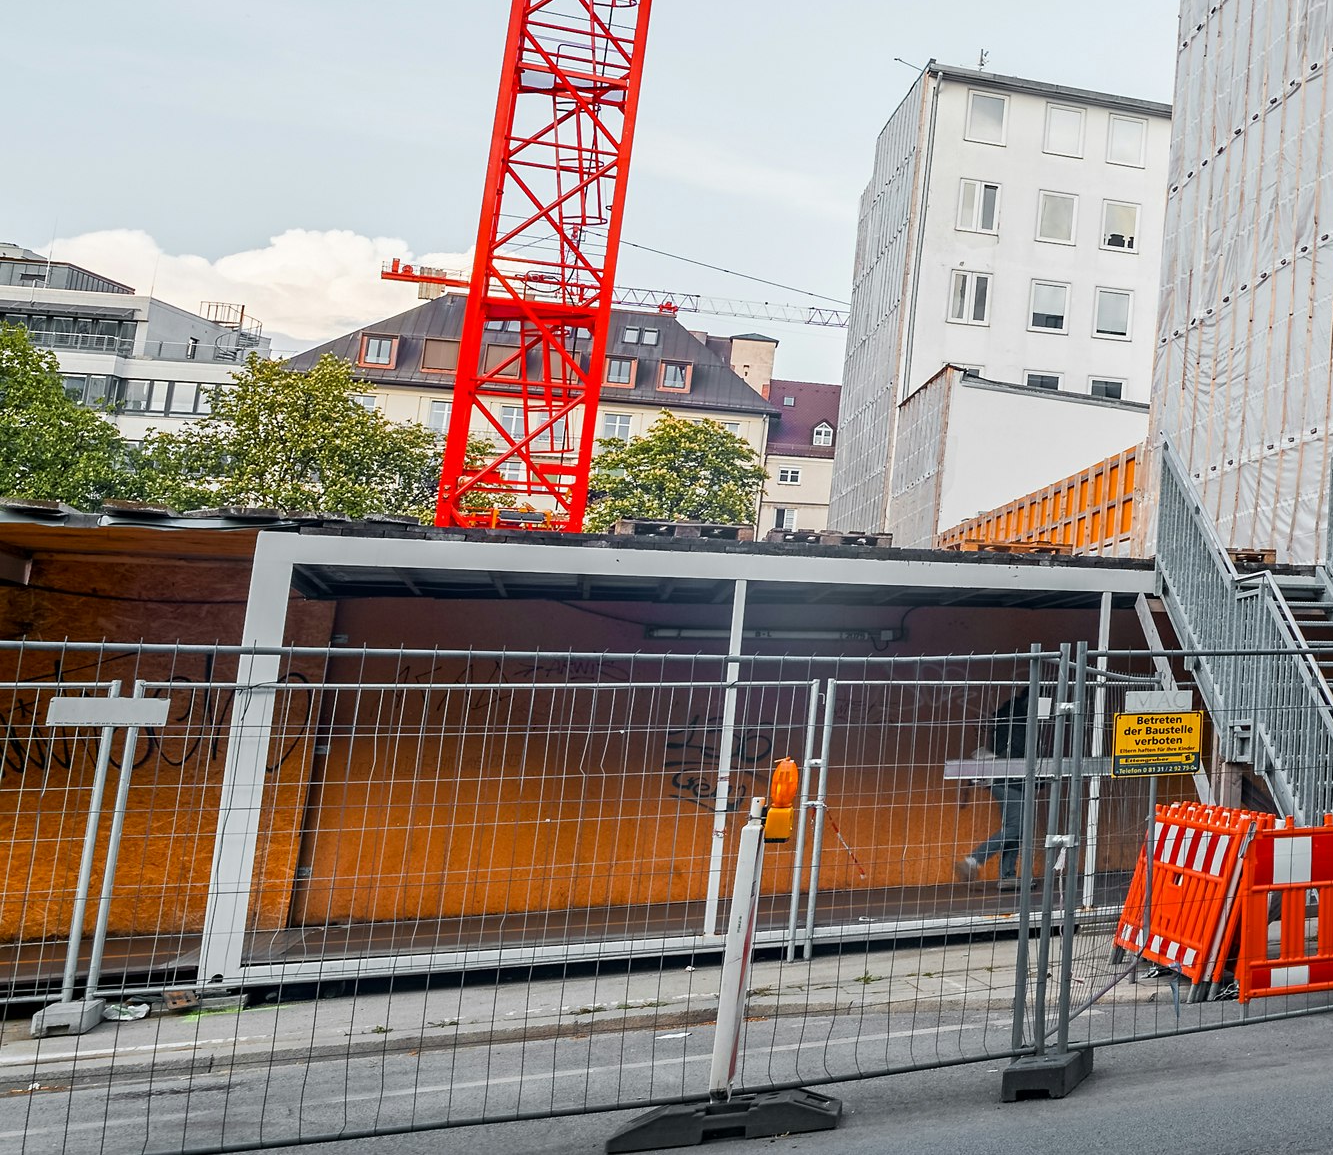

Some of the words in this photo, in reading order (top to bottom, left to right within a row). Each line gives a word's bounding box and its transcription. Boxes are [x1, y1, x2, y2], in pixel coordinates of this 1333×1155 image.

[1136, 716, 1182, 725] Betreten
[1124, 727, 1142, 736] der
[1145, 725, 1193, 735] Baustelle
[1134, 736, 1183, 746] verboten
